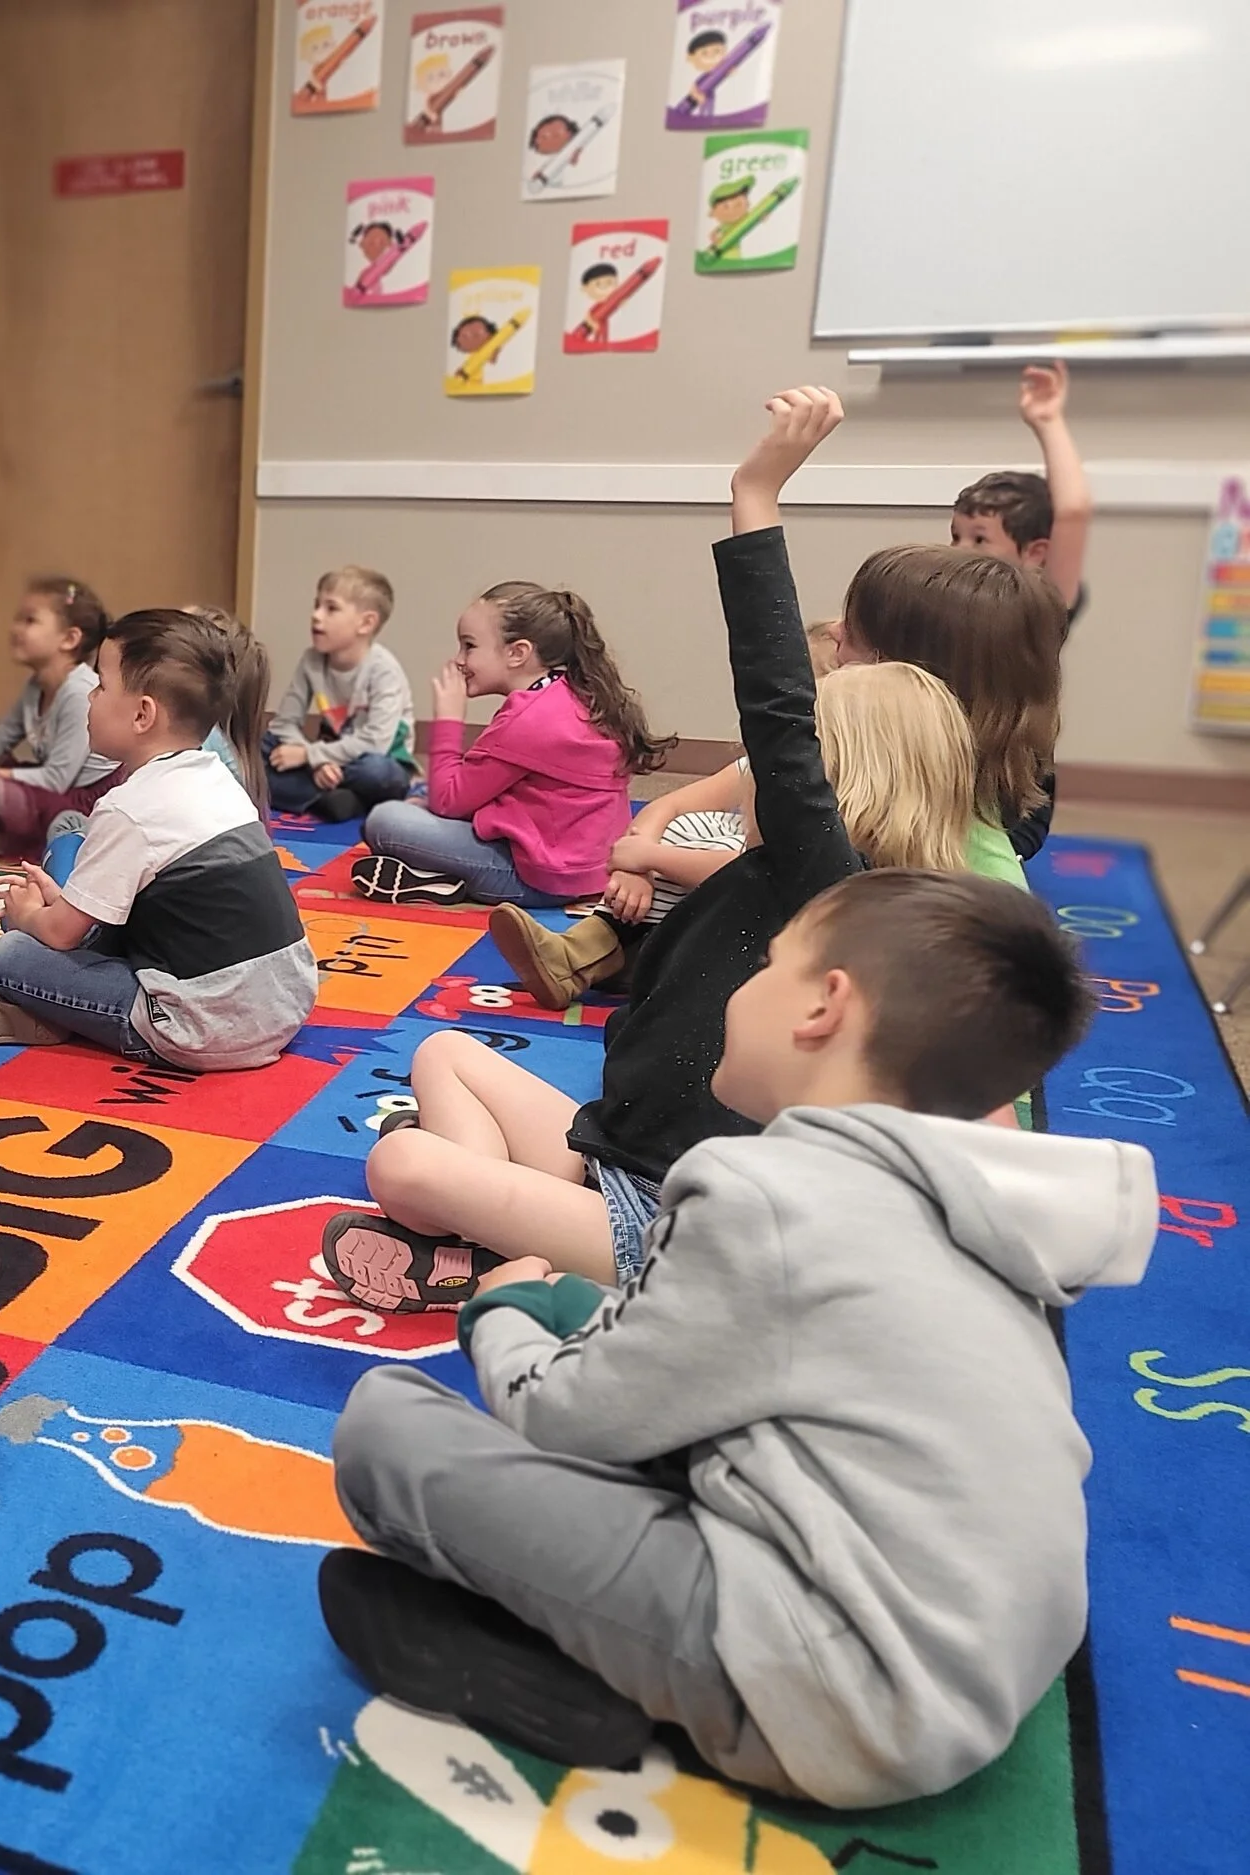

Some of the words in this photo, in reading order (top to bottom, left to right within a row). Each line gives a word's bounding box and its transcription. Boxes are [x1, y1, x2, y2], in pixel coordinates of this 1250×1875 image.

[425, 32, 486, 49] brown
[720, 153, 788, 180] green
[600, 238, 637, 260] red
[316, 934, 410, 977] pin
[94, 1064, 198, 1104] wi
